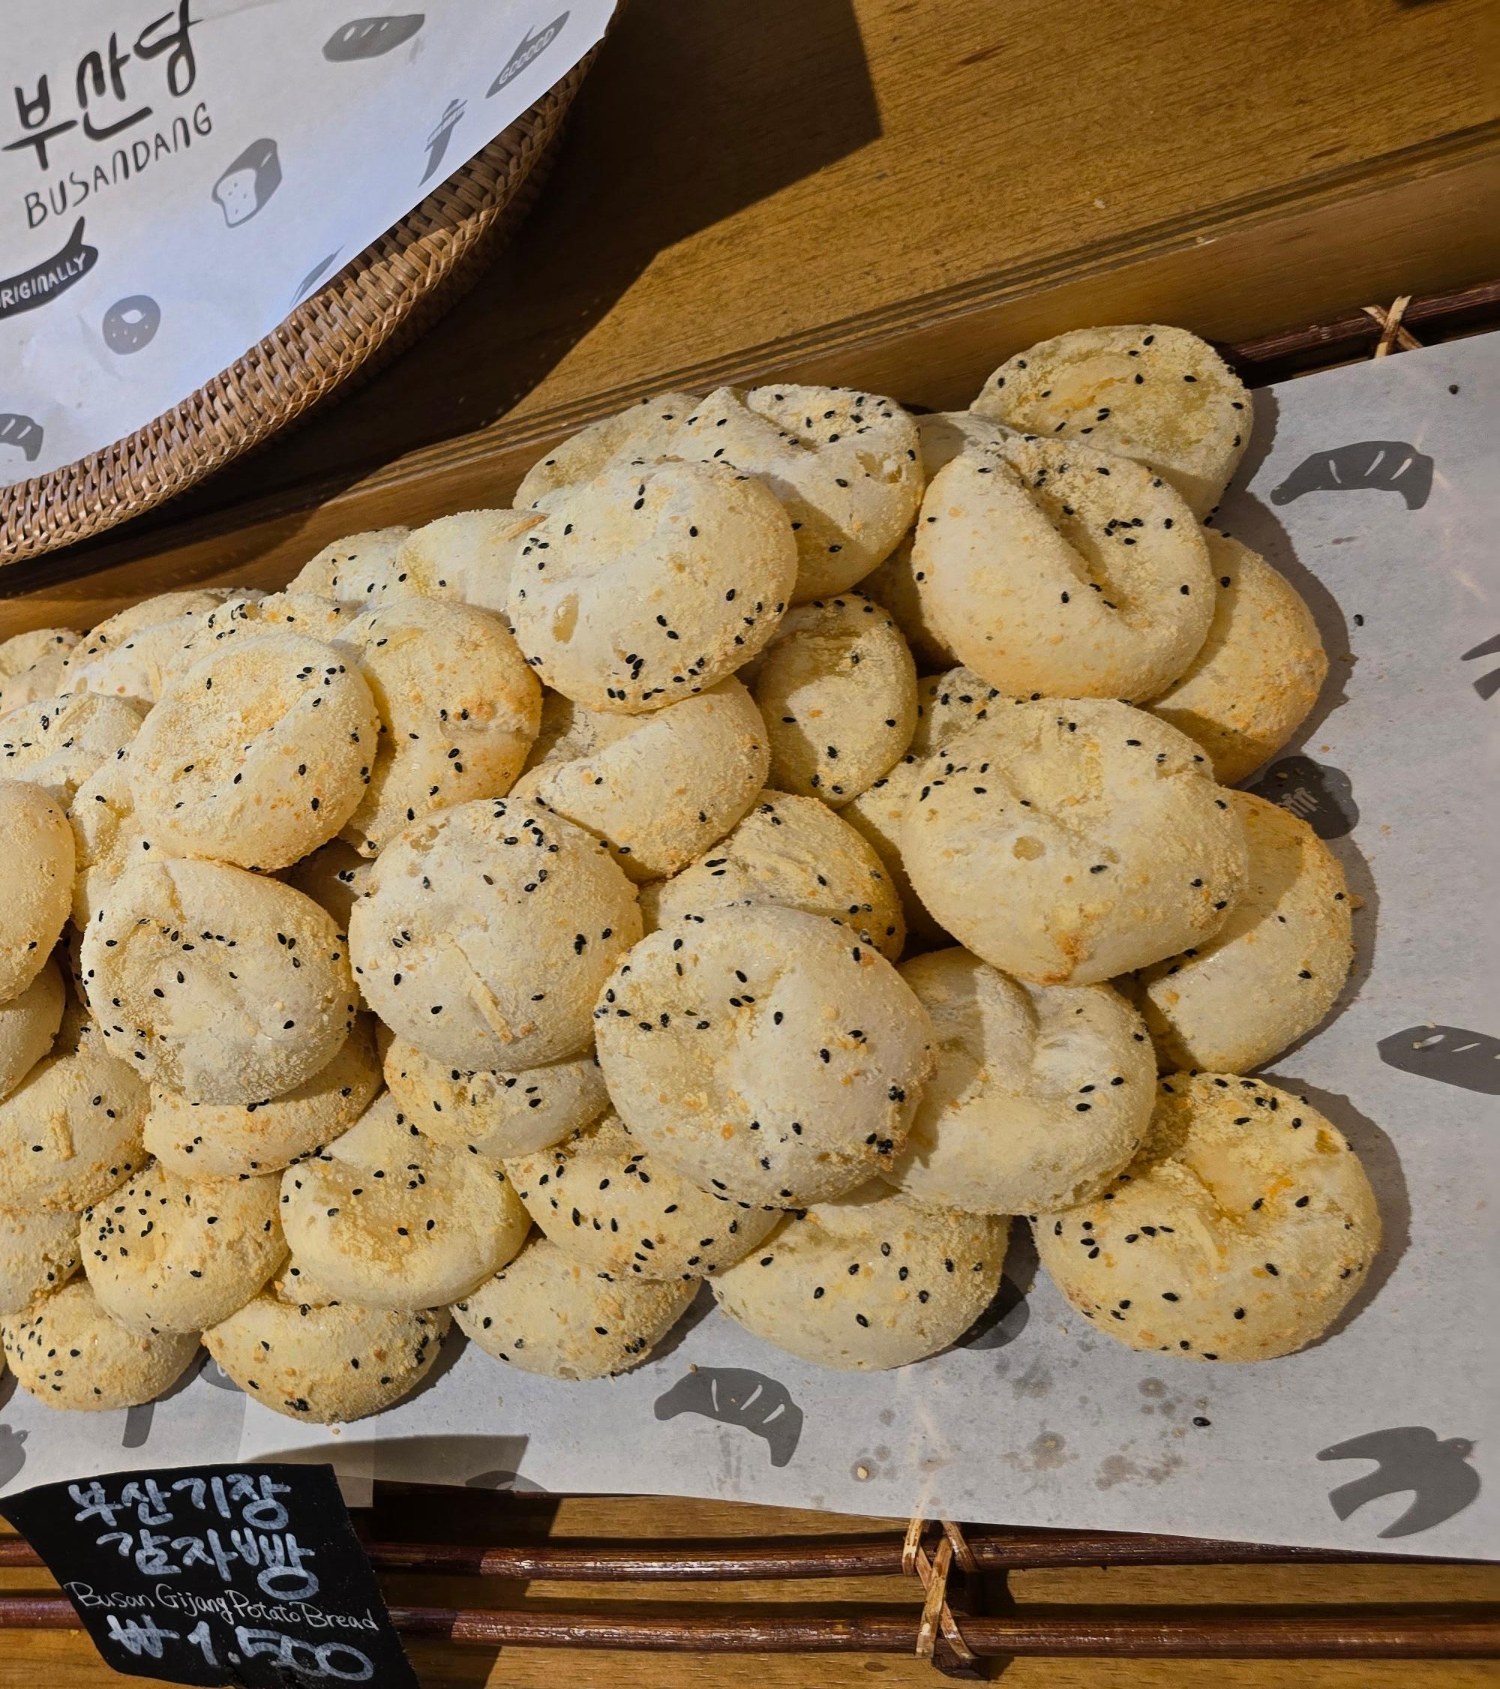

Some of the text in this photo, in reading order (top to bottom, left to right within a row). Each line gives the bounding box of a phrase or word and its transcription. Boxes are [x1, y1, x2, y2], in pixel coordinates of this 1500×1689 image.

[1, 0, 204, 171] 부산당
[23, 102, 212, 230] BUSANDANG
[63, 1581, 380, 1631] Busan Gijang Potato Bread
[96, 1527, 320, 1600] 감자빵
